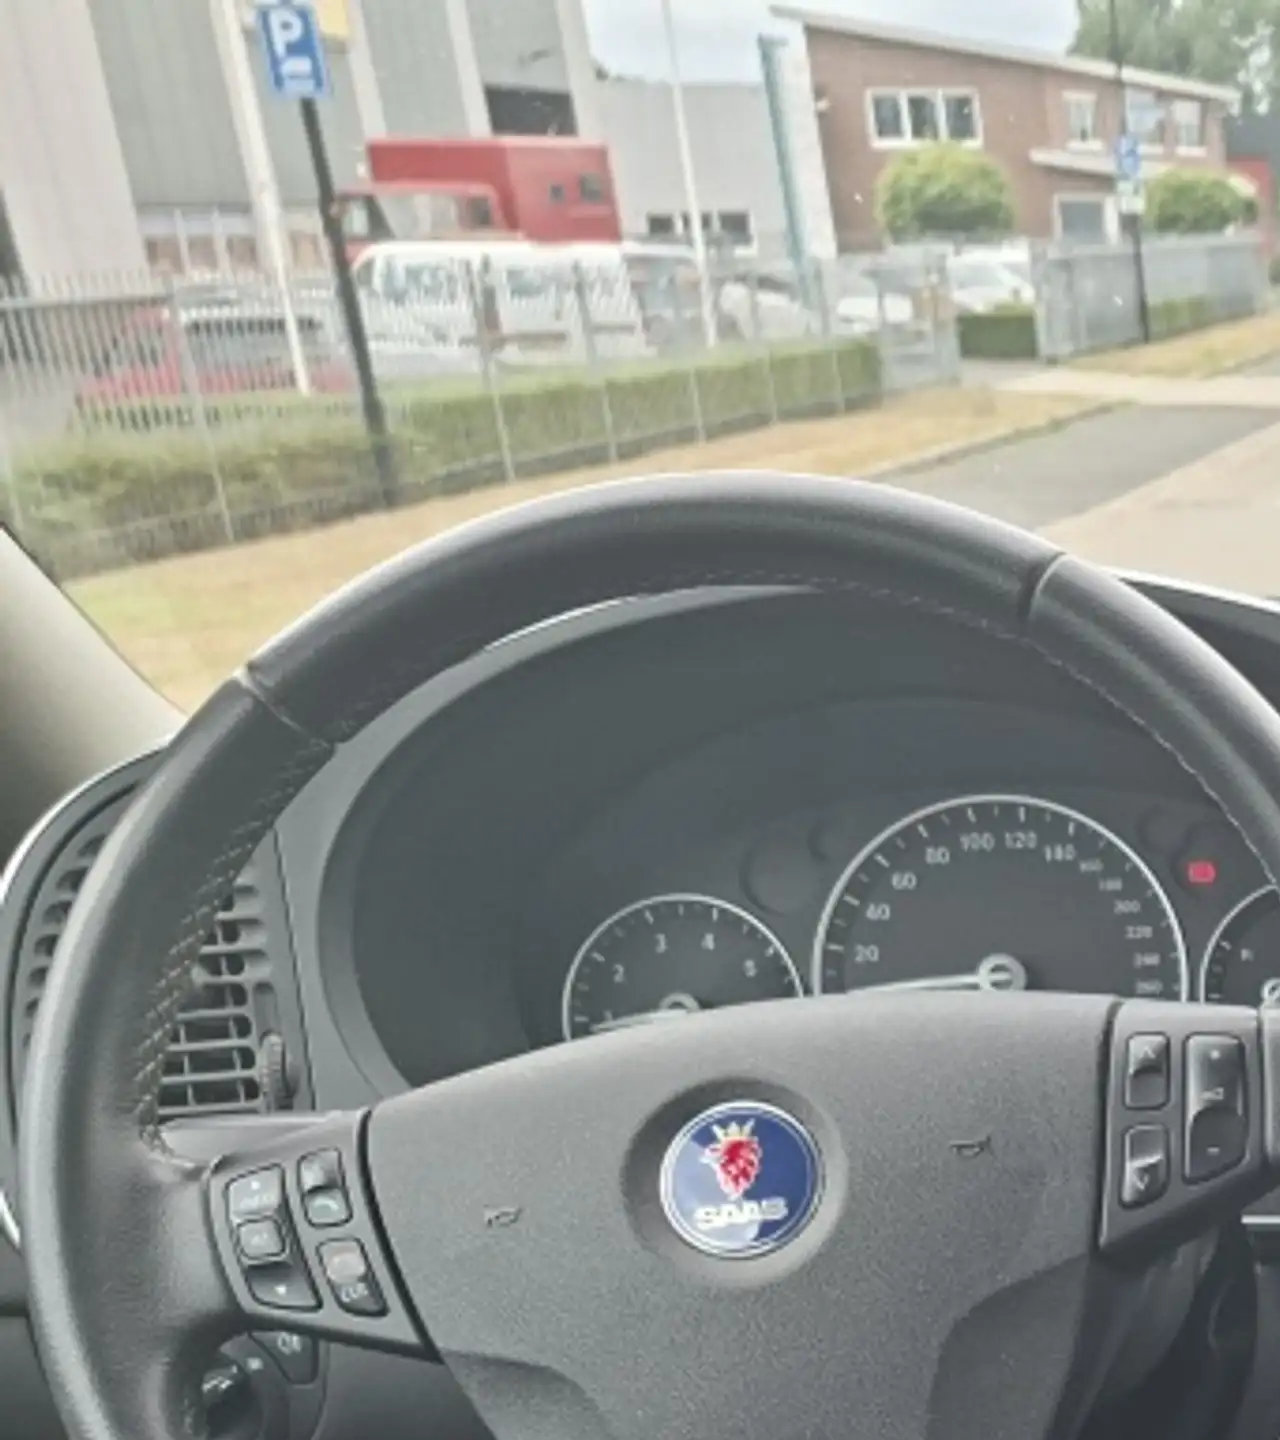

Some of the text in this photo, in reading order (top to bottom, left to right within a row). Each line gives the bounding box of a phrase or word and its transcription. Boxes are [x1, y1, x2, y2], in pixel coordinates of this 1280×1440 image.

[269, 8, 303, 57] P
[959, 832, 995, 851] 100
[1005, 831, 1037, 849] 120
[924, 846, 950, 865] 80
[891, 872, 917, 890] 60
[865, 903, 891, 921] 40
[655, 933, 668, 953] 3
[702, 932, 716, 951] 4
[854, 944, 880, 963] 20
[612, 964, 625, 984] 2
[694, 1196, 788, 1230] SAAB
